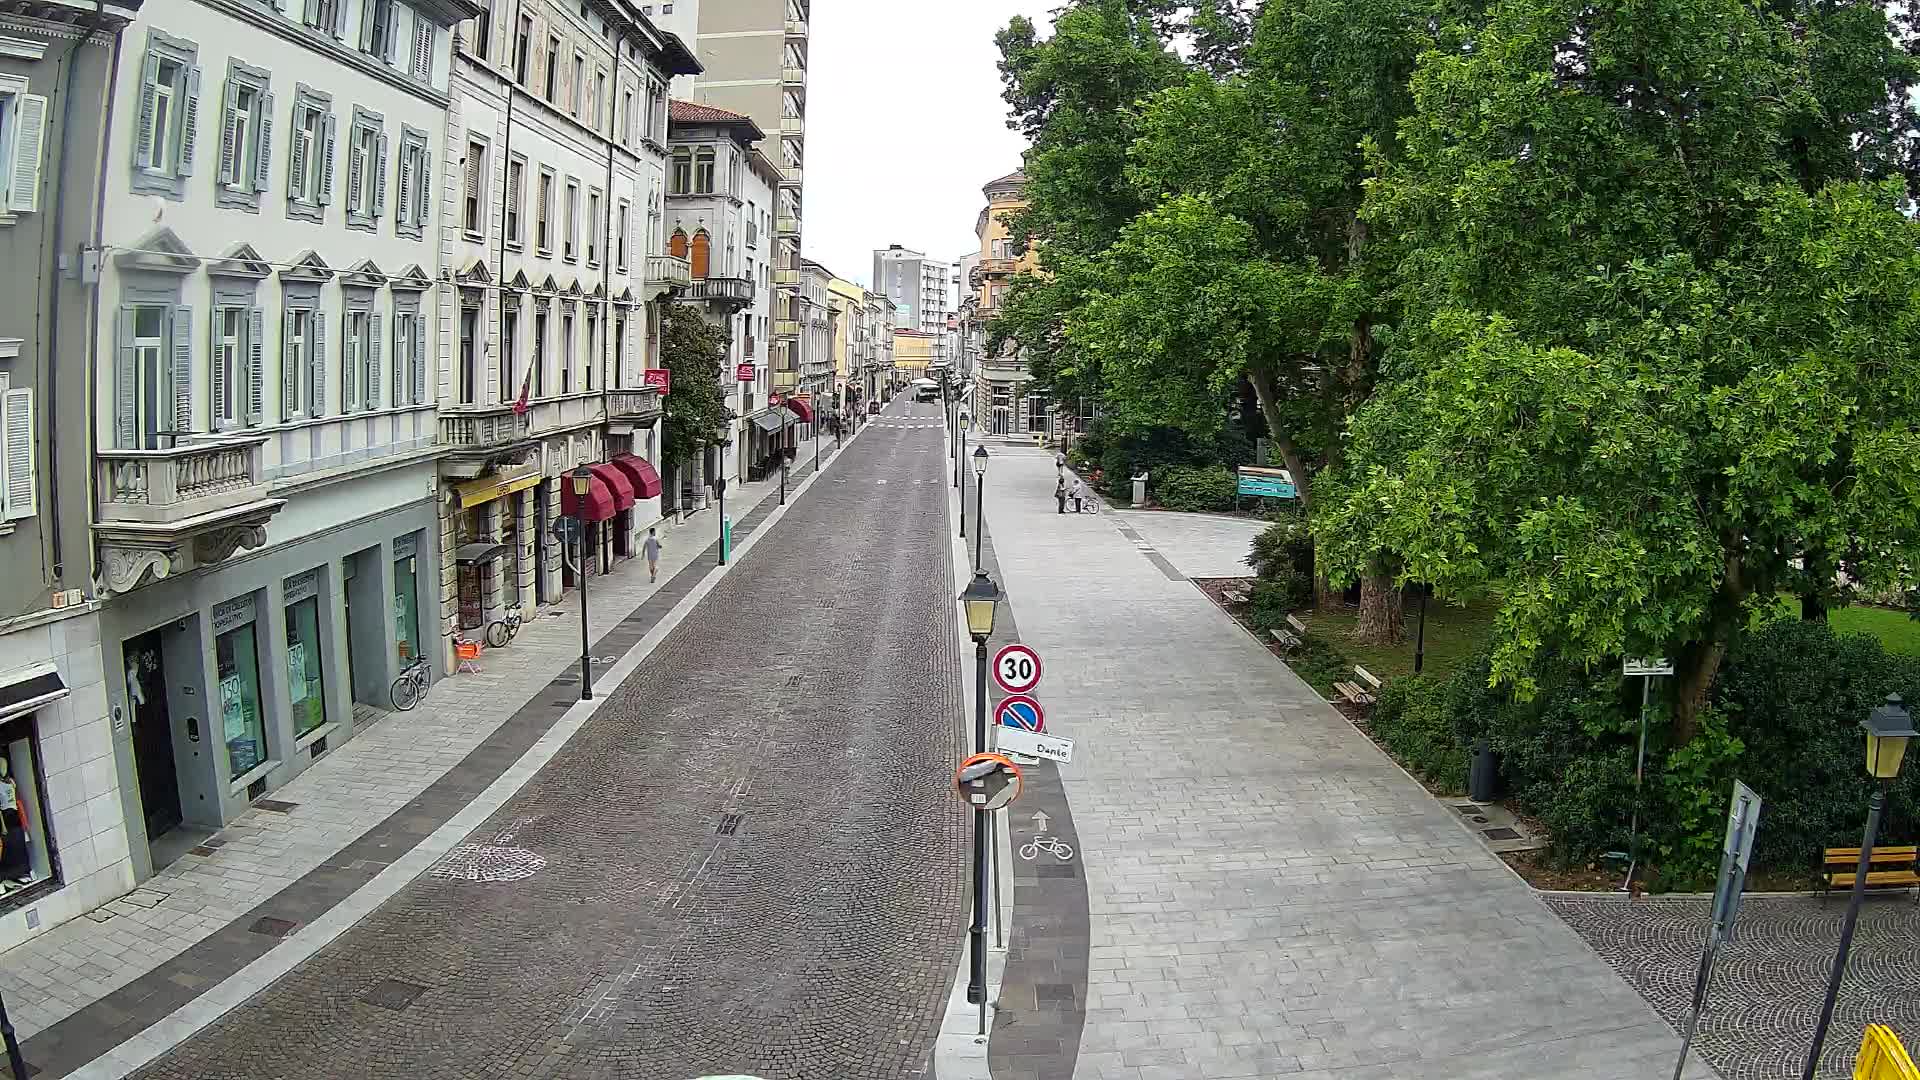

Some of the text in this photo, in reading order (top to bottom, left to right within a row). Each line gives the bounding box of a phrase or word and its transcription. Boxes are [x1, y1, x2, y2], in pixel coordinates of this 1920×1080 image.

[1005, 657, 1032, 680] 30
[220, 677, 240, 702] 130
[1036, 743, 1067, 758] Dante
